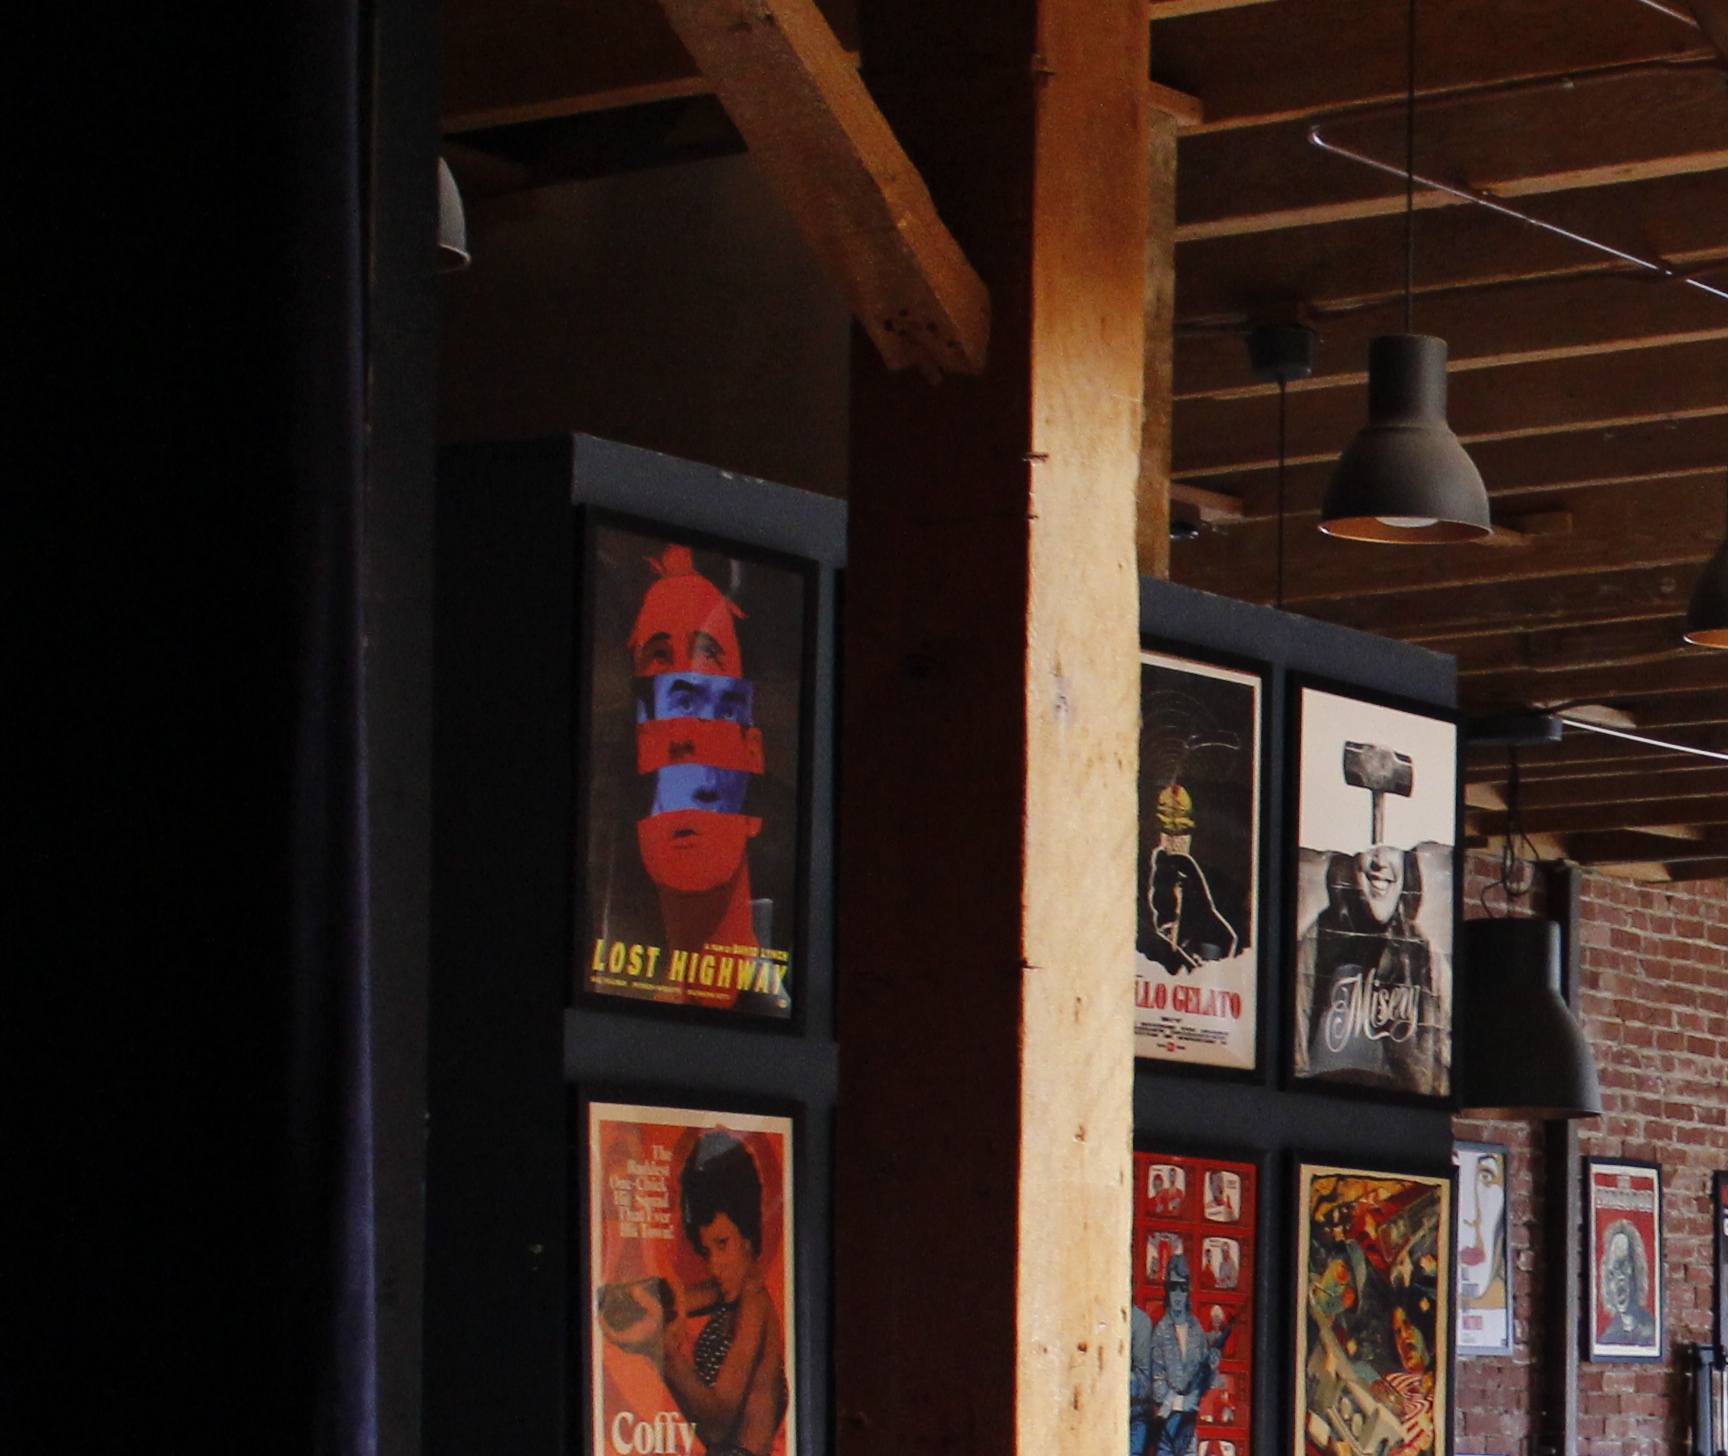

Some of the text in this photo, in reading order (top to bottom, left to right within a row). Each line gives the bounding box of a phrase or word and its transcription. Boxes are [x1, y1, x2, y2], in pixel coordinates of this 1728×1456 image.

[592, 939, 661, 977] LOST
[669, 950, 788, 994] HIGHWAY
[1173, 985, 1242, 1019] GELATO
[1326, 967, 1420, 1052] Misery
